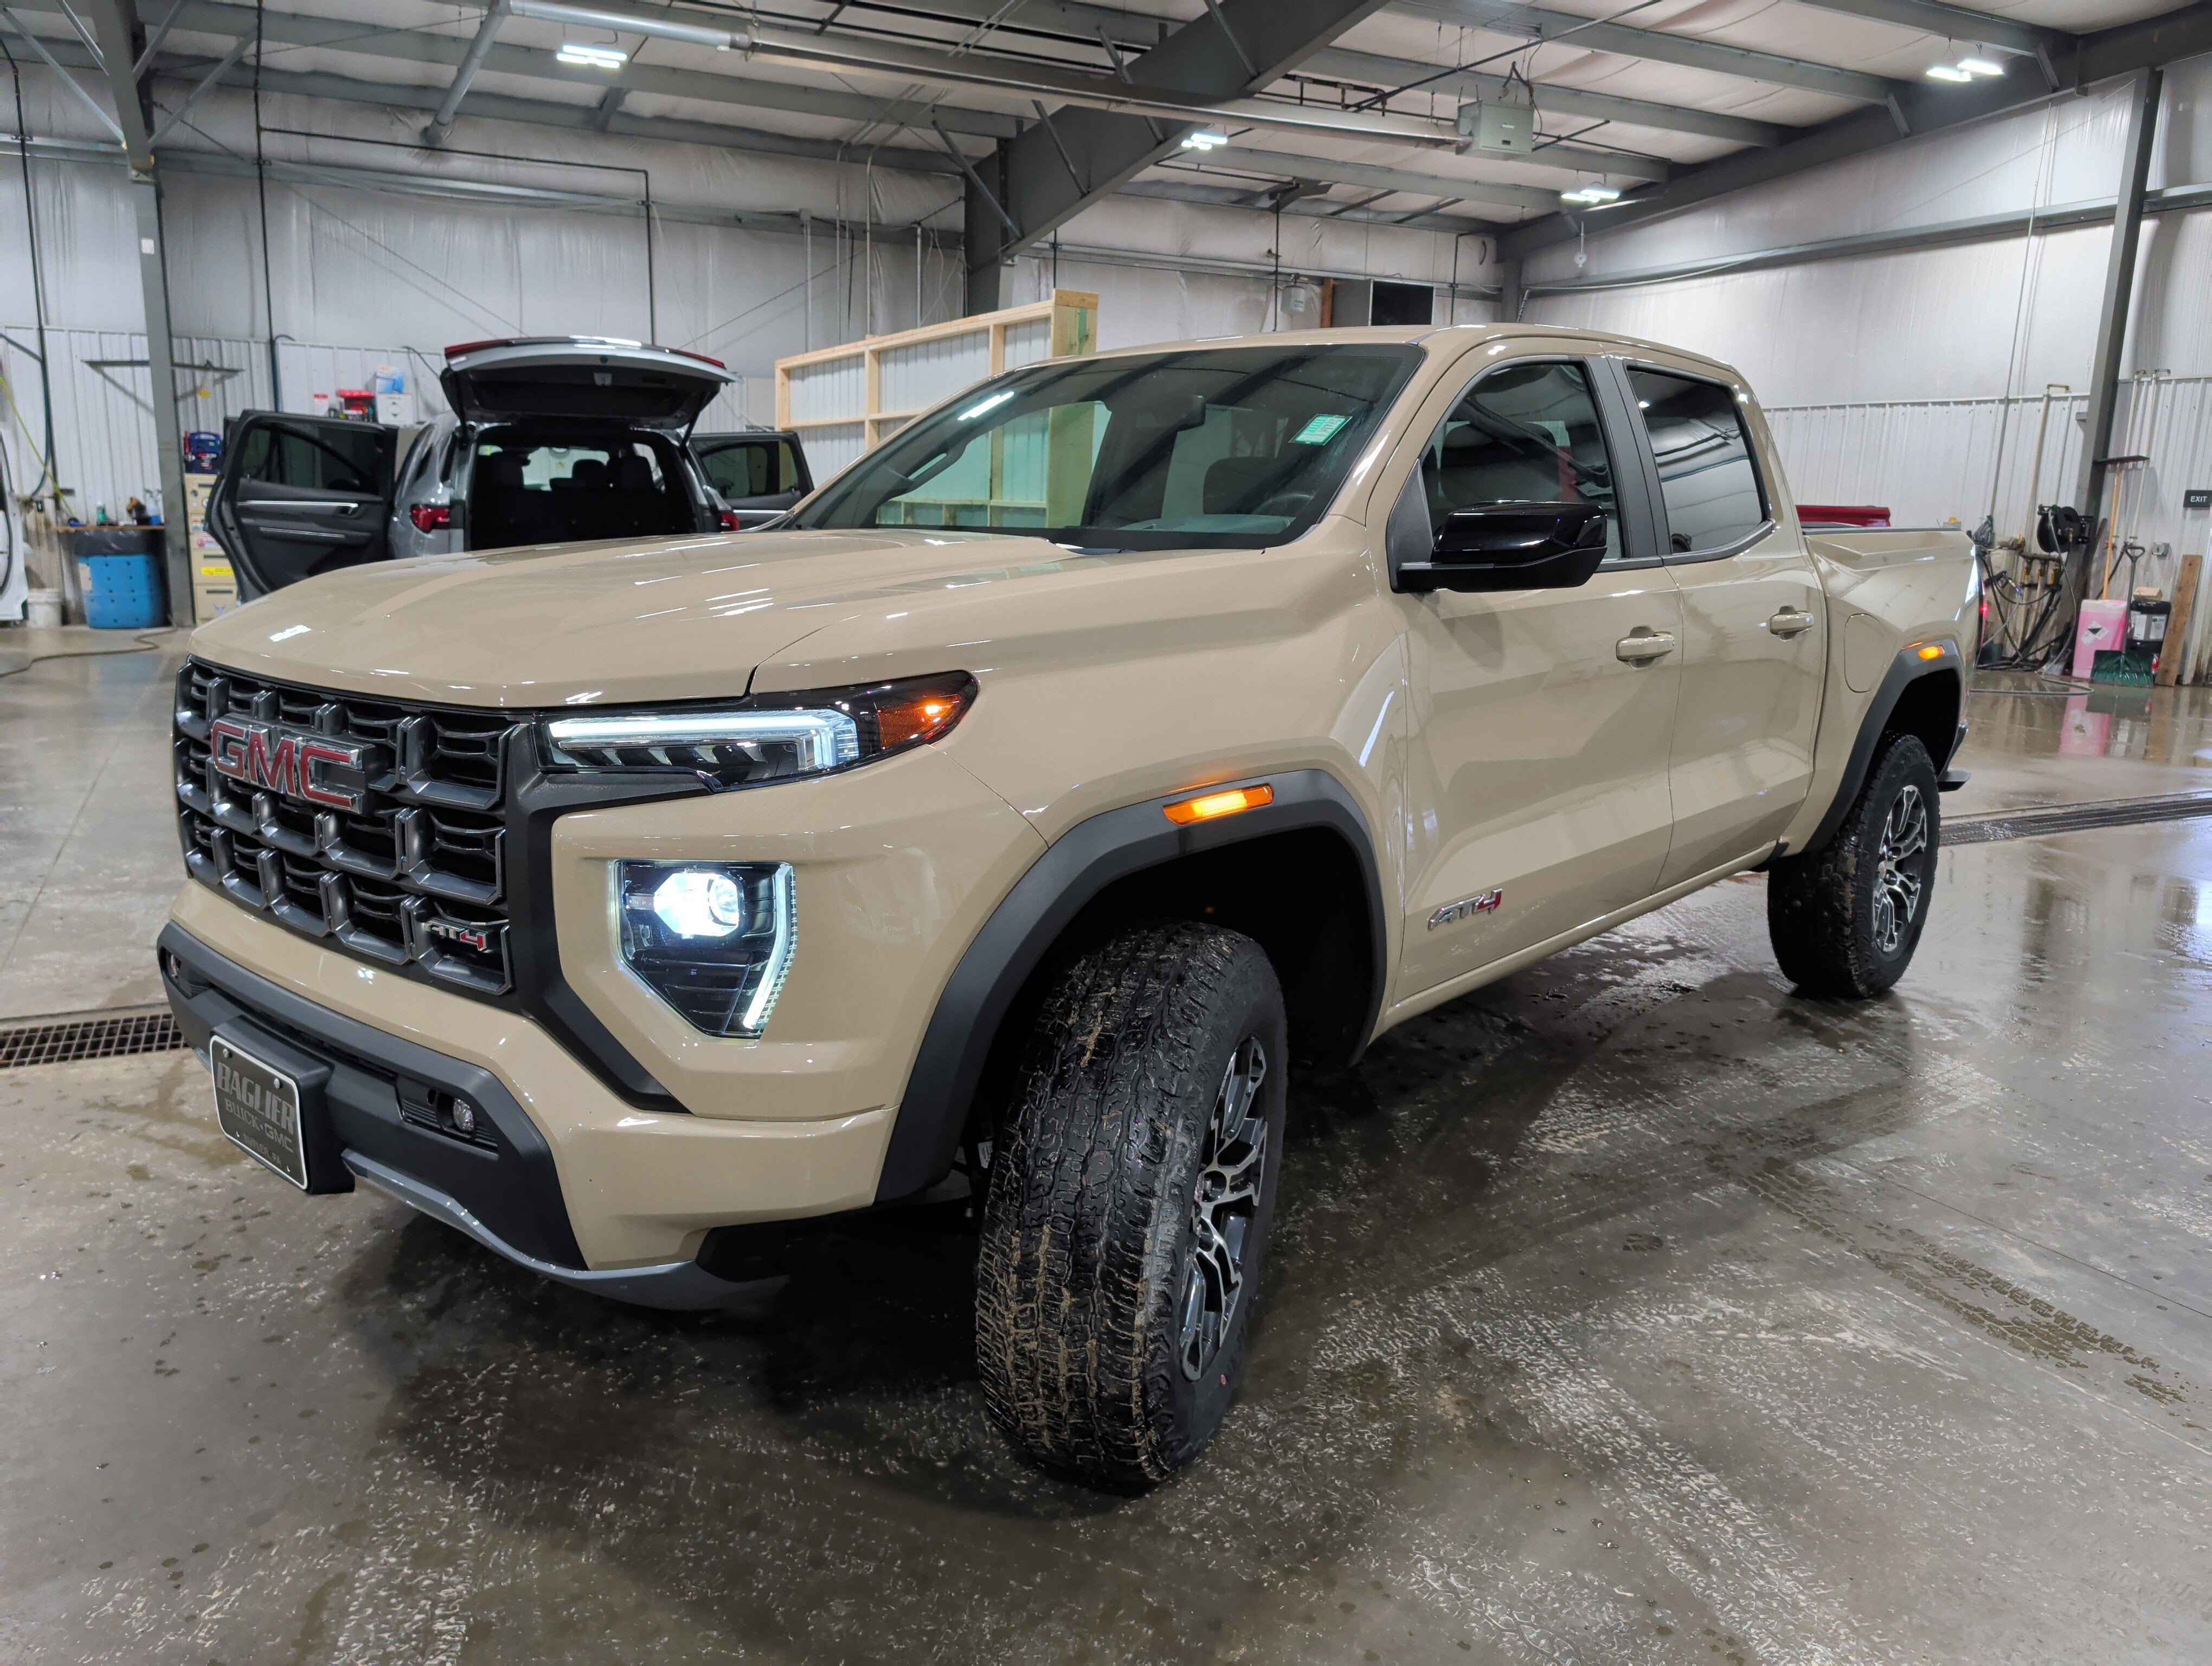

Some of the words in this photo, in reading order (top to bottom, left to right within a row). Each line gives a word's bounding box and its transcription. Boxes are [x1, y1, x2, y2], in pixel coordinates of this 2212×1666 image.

[211, 719, 363, 813] GMC
[423, 920, 487, 951] AT4
[1427, 888, 1503, 931] AT4
[217, 1061, 295, 1135] BAGLIER
